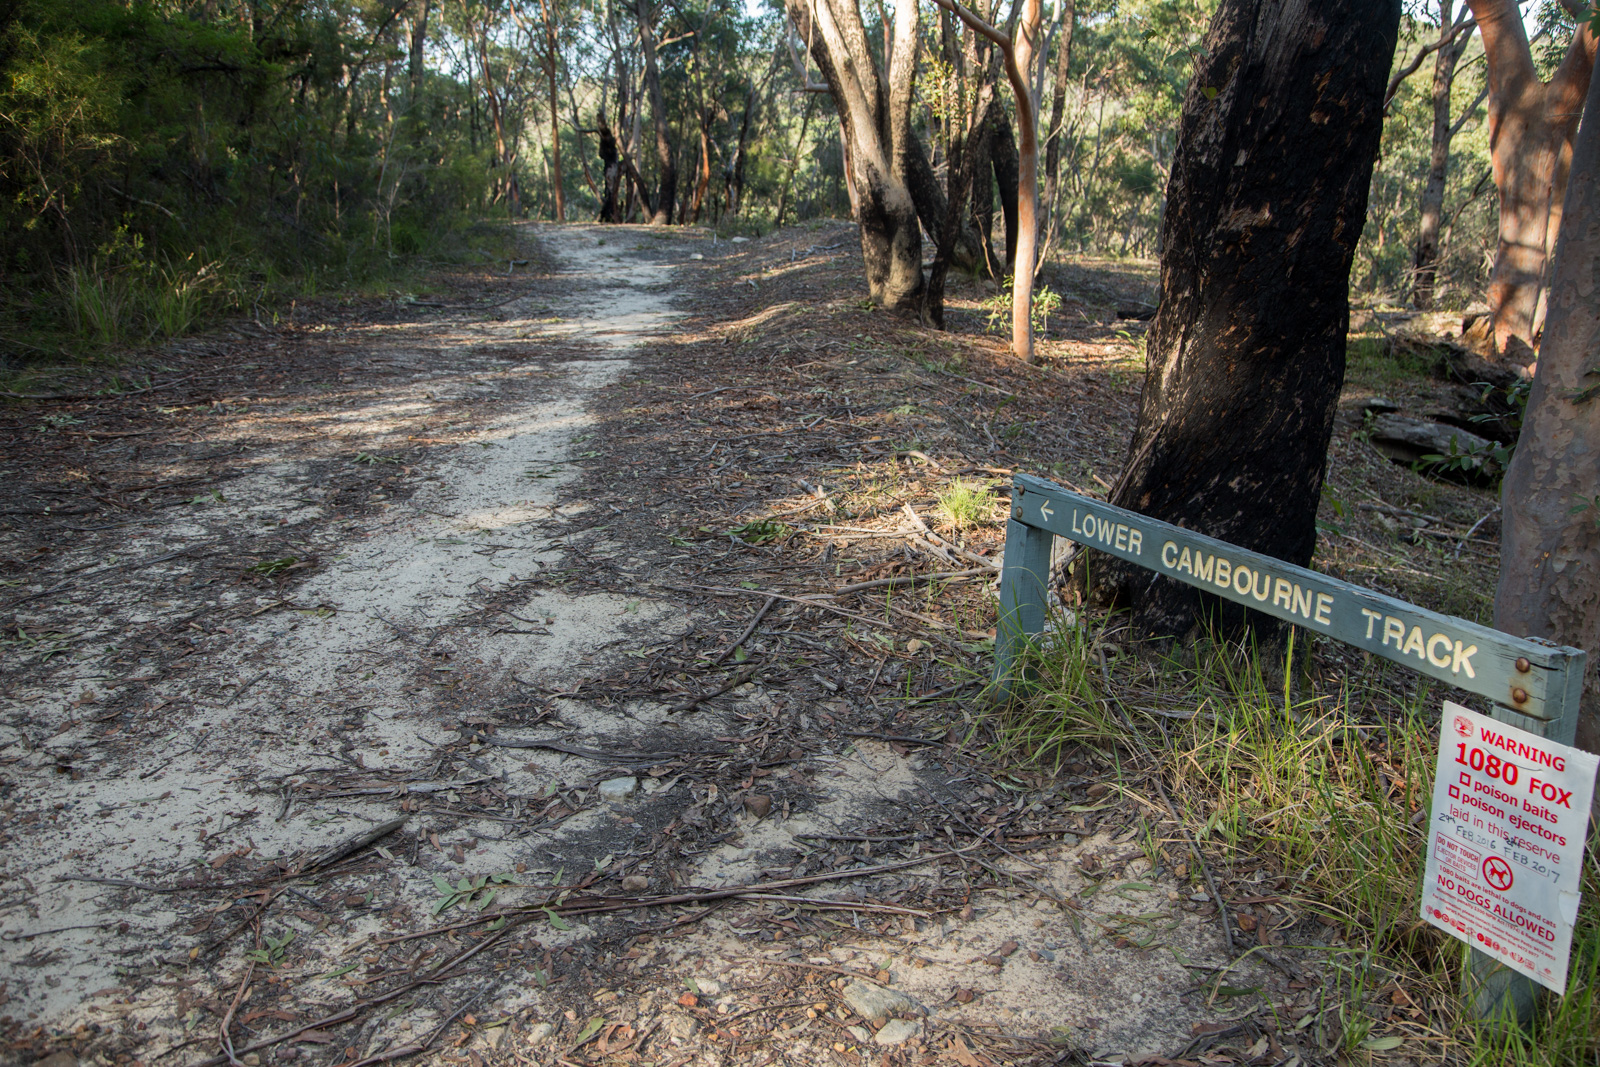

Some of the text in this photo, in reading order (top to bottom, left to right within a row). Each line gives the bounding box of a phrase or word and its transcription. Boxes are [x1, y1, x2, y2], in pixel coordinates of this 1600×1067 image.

[1072, 508, 1478, 678] LOWER CAMBOURNE TRACK
[1454, 740, 1573, 809] 1080 FOX
[1479, 727, 1566, 772] WARNING
[1461, 790, 1567, 849] poison ejectors
[1473, 778, 1558, 824] poison baits
[1437, 835, 1478, 862] DO NOT TOUCH
[1449, 803, 1560, 864] laid in this reserve
[1455, 823, 1474, 841] FEB
[1476, 832, 1496, 851] 2016
[1502, 845, 1528, 866] FEB
[1531, 860, 1560, 885] 2017
[1437, 874, 1555, 943] NO DOGS ALLOWED
[1439, 864, 1556, 928] 1080 baits are lethal to dogs and cats
